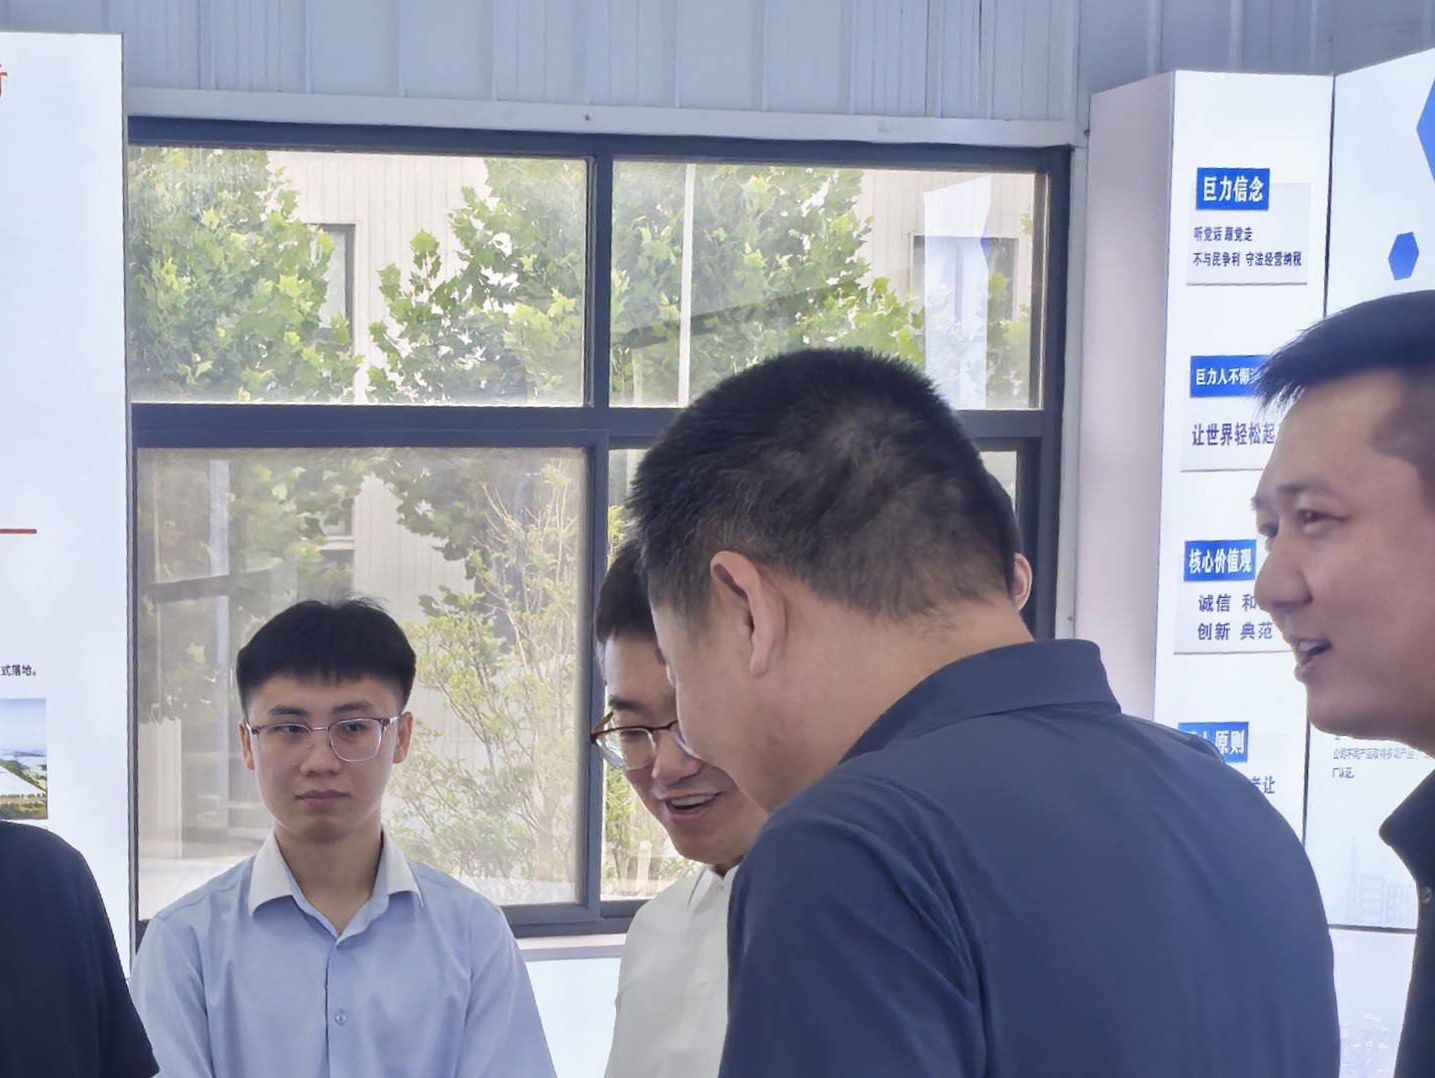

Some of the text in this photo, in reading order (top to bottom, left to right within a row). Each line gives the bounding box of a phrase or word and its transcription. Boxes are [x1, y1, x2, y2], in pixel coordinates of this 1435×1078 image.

[1203, 175, 1263, 202] 巨力信念
[1193, 251, 1301, 267] 不与民争利 守法经营纳税
[1189, 547, 1252, 574] 核心价值观
[1198, 593, 1231, 612] 诚信
[1197, 621, 1273, 640] 创新 典范
